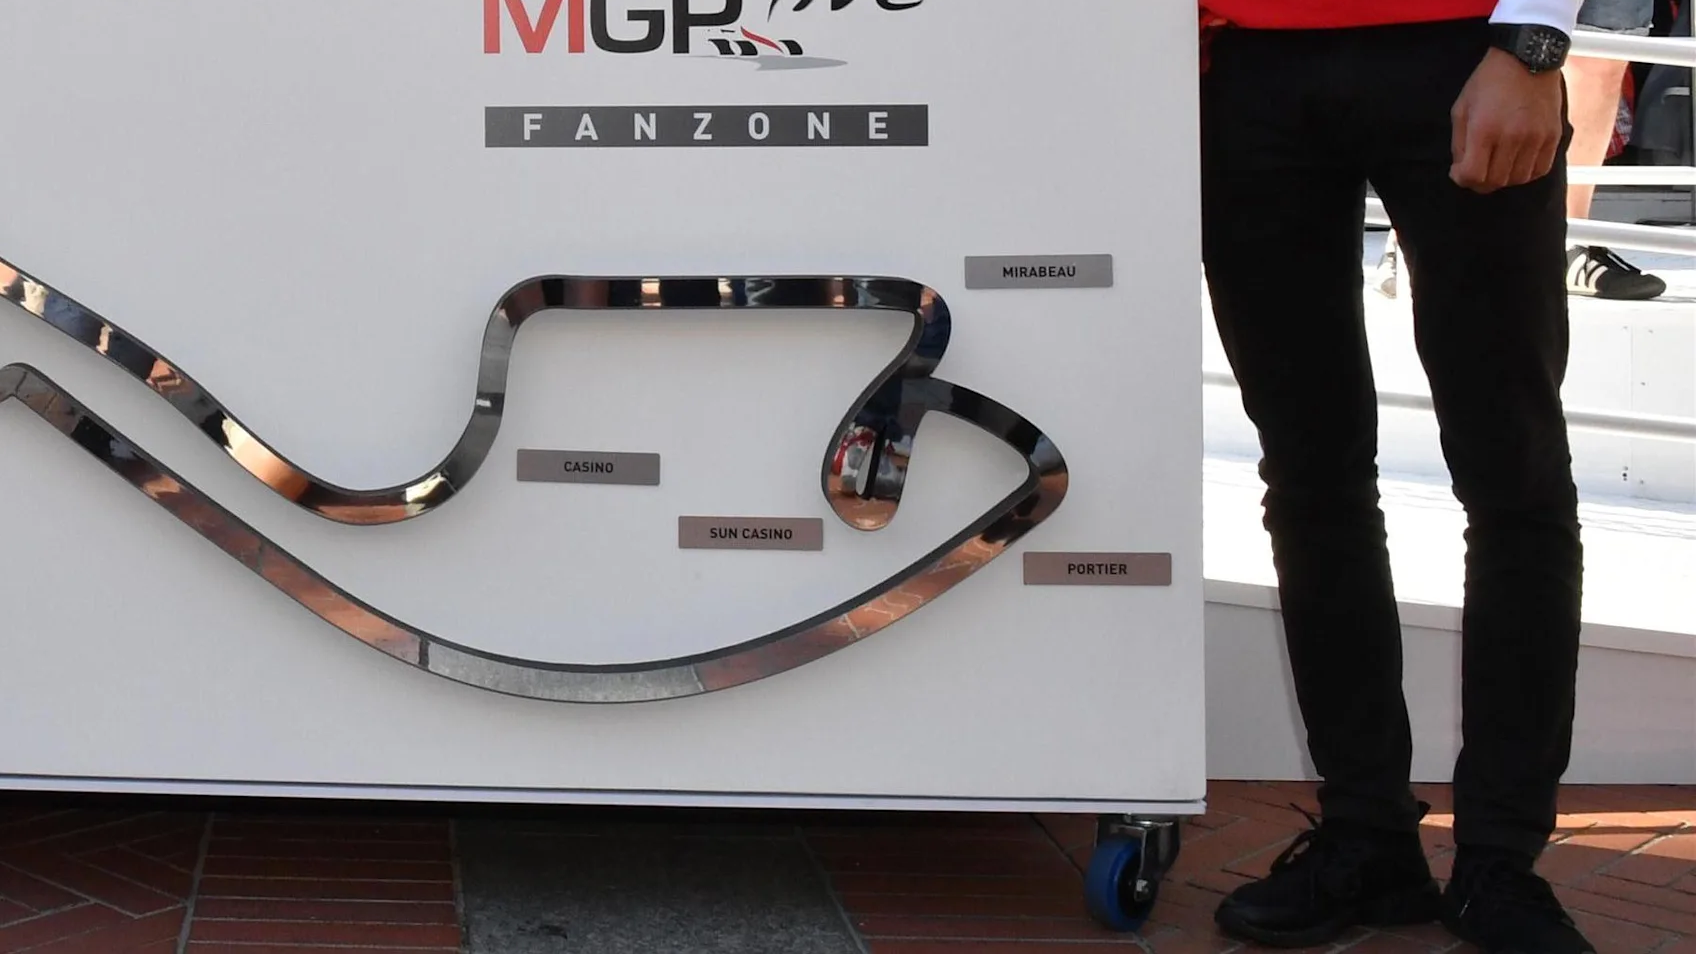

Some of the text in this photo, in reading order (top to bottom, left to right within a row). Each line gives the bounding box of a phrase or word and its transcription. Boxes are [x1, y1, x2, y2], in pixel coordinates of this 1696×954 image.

[522, 112, 889, 141] FANZONE
[1003, 265, 1077, 278] MIRABEAU
[563, 461, 615, 474] CASINO
[709, 527, 793, 540] SUN CASINO
[1067, 563, 1128, 575] PORTIER
